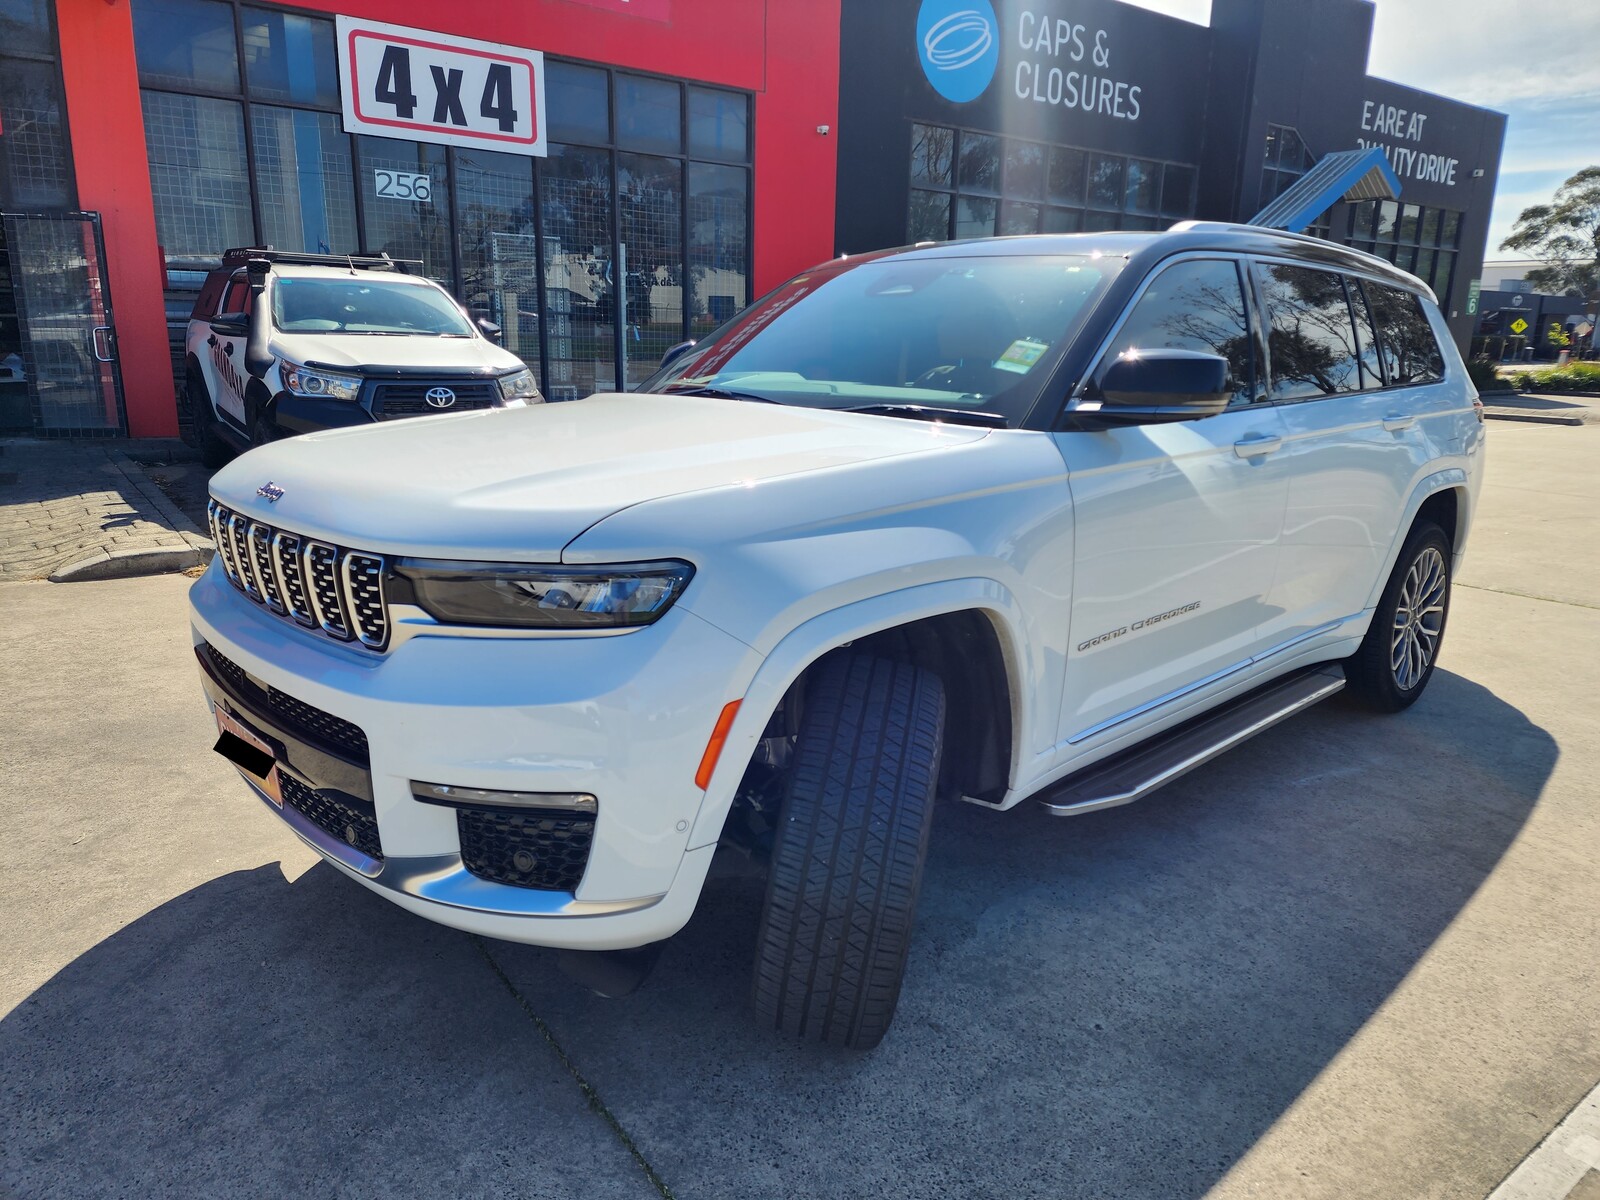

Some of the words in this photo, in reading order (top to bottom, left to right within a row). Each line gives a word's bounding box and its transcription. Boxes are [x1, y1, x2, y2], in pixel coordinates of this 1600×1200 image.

[1018, 10, 1086, 61] CAPS
[1092, 29, 1109, 69] &
[1015, 60, 1142, 120] CLOSURES
[1361, 100, 1375, 131] E
[1373, 103, 1408, 138] ARE
[1406, 111, 1427, 142] AT
[375, 171, 430, 200] 256
[1416, 152, 1459, 186] DRIVE
[1469, 298, 1477, 314] 6
[1077, 626, 1128, 652] GRAND
